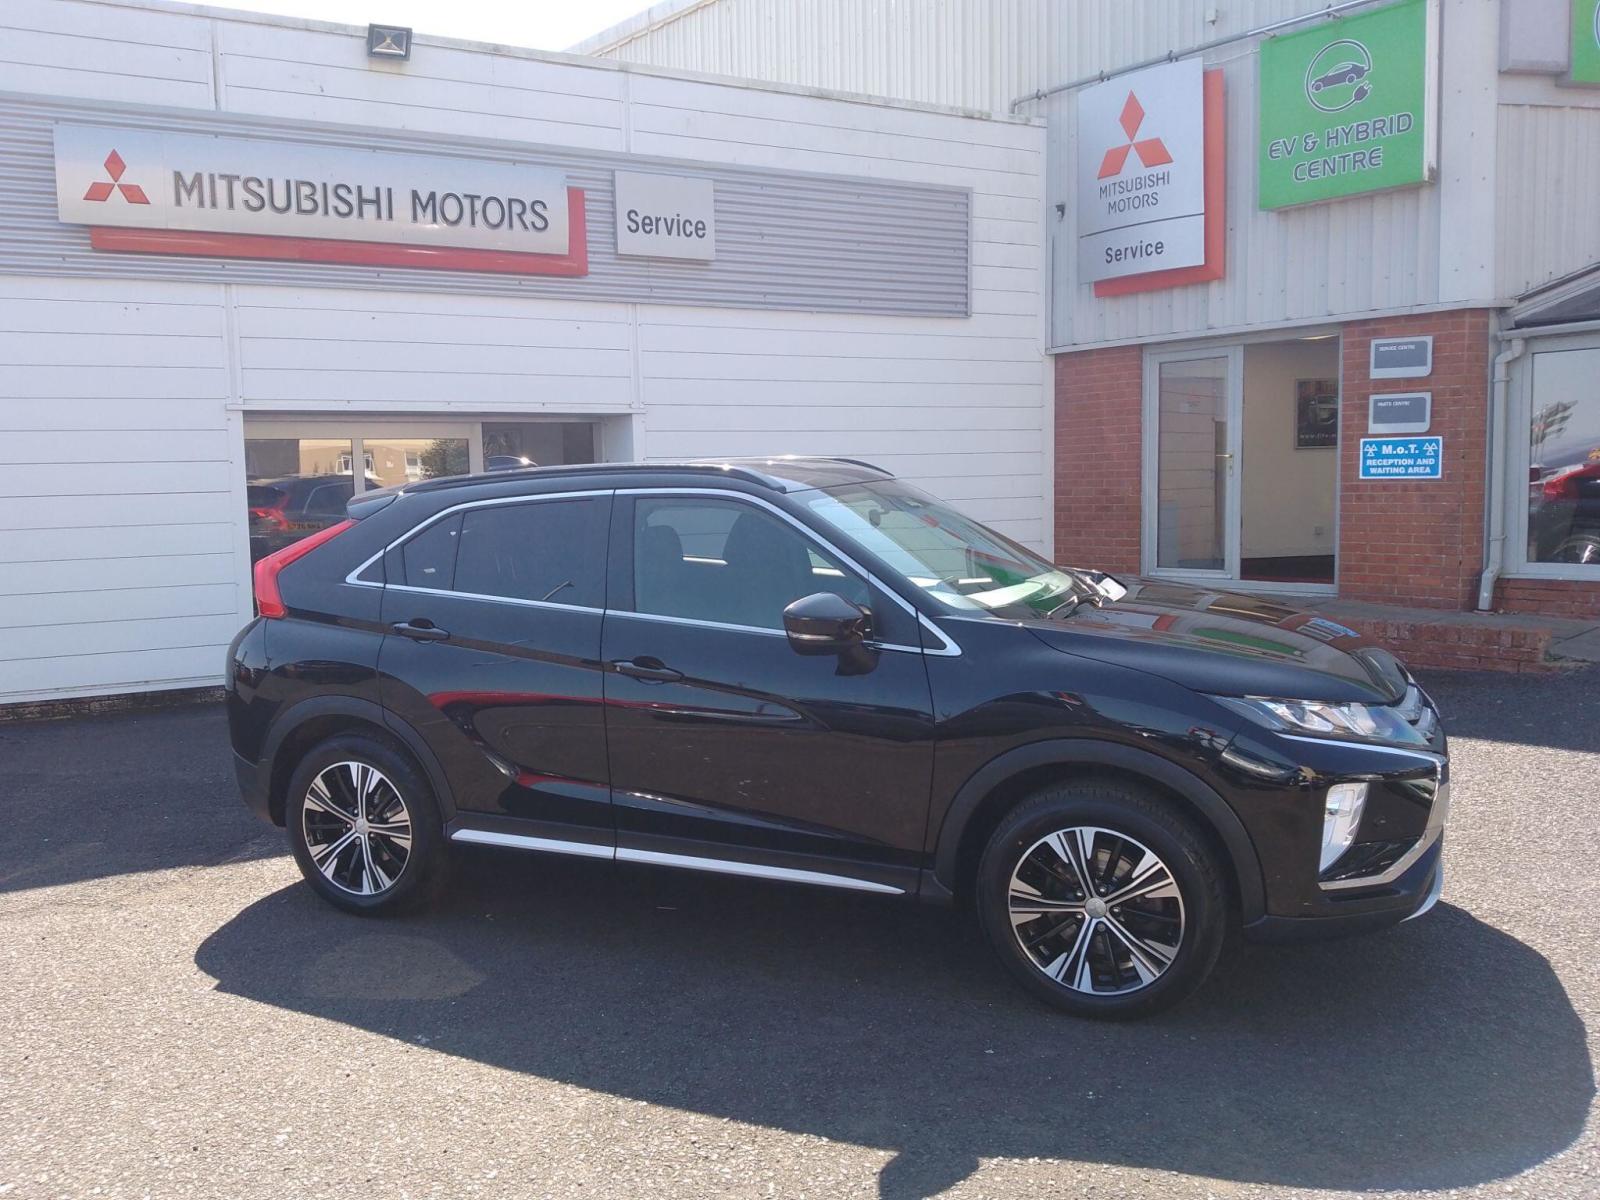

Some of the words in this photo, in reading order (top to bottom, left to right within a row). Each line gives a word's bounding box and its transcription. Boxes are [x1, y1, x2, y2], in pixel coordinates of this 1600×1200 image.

[1268, 136, 1298, 160] EV
[1303, 131, 1319, 153] &
[1325, 111, 1415, 149] HYBRID
[1293, 146, 1383, 183] CENTRE
[1099, 170, 1170, 200] MITSUBISHI
[173, 170, 393, 222] MITSUBISHI
[411, 189, 549, 233] MOTORS
[1108, 191, 1159, 215] MOTORS
[627, 208, 706, 239] Service
[1105, 240, 1164, 264] Service
[1366, 458, 1414, 466] RECEPTION
[1382, 444, 1419, 455] M.o.T.
[1369, 466, 1406, 474] WAITING
